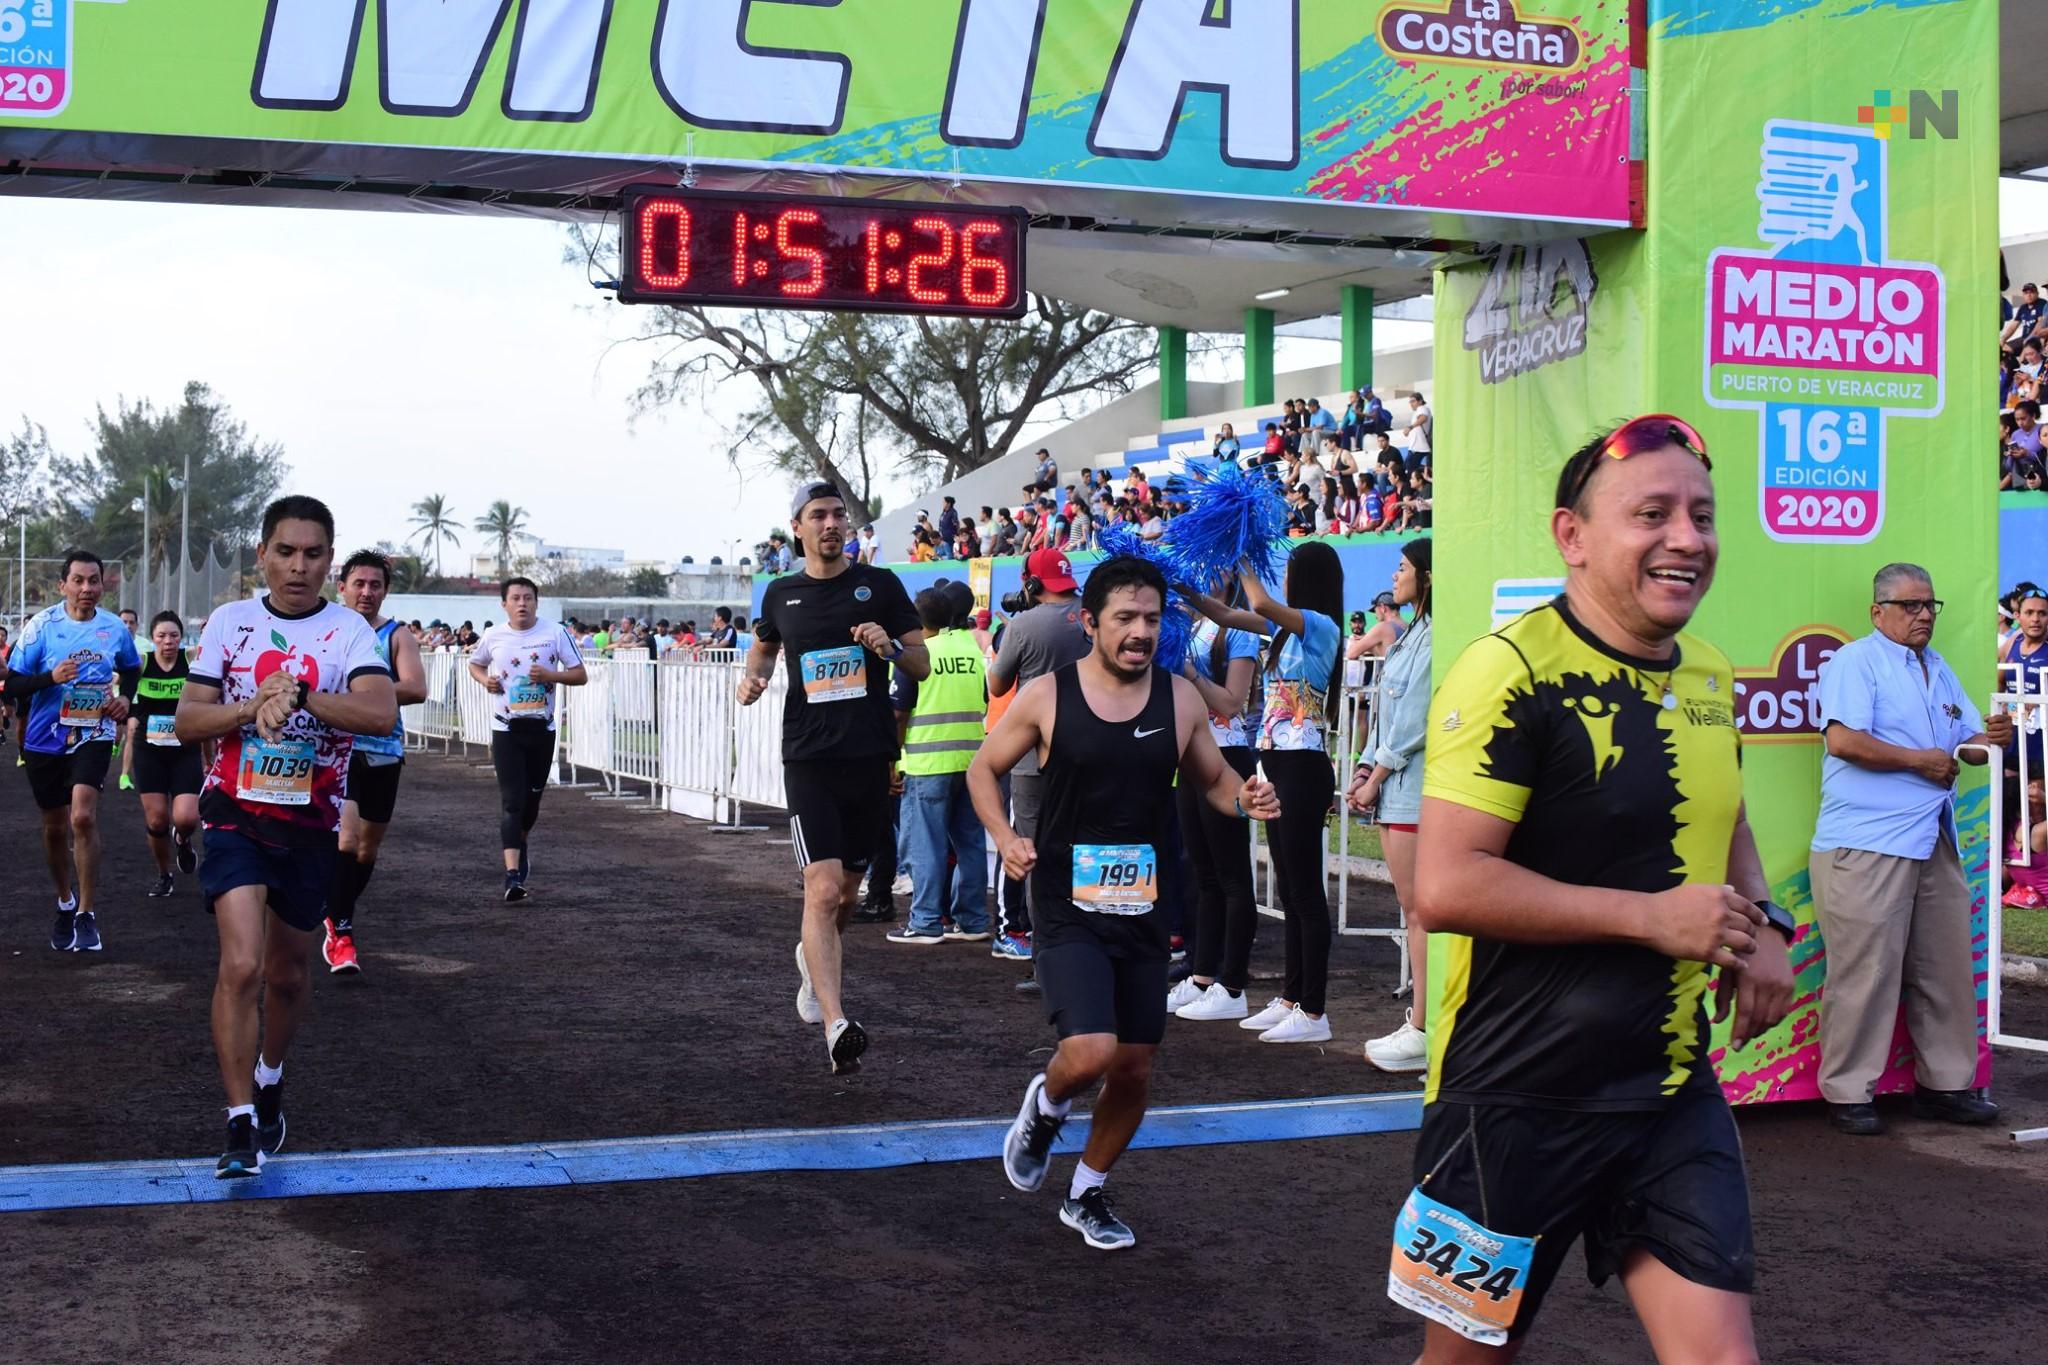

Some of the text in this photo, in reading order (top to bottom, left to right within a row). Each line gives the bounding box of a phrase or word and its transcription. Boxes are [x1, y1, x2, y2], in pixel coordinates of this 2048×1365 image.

[0, 0, 53, 43] 6ª
[1466, 0, 1500, 20] La
[1396, 13, 1563, 64] Costeña
[1724, 266, 1924, 326] MEDIO
[1482, 314, 1585, 377] VERACRUZ
[1723, 321, 1923, 366] MARATÓN
[1722, 374, 1924, 399] PUERTO DE VERACRUZ
[1777, 408, 1867, 464] 16ª
[1775, 465, 1867, 487] EDICIÓN
[1777, 495, 1867, 528] 2020
[815, 659, 862, 681] 8707
[934, 656, 977, 675] JUEZ
[70, 698, 103, 711] 5727
[518, 693, 545, 703] 5793
[157, 723, 175, 734] 120
[259, 755, 312, 778] 1039
[1098, 863, 1153, 887] 1991
[1403, 1227, 1521, 1303] 3424
